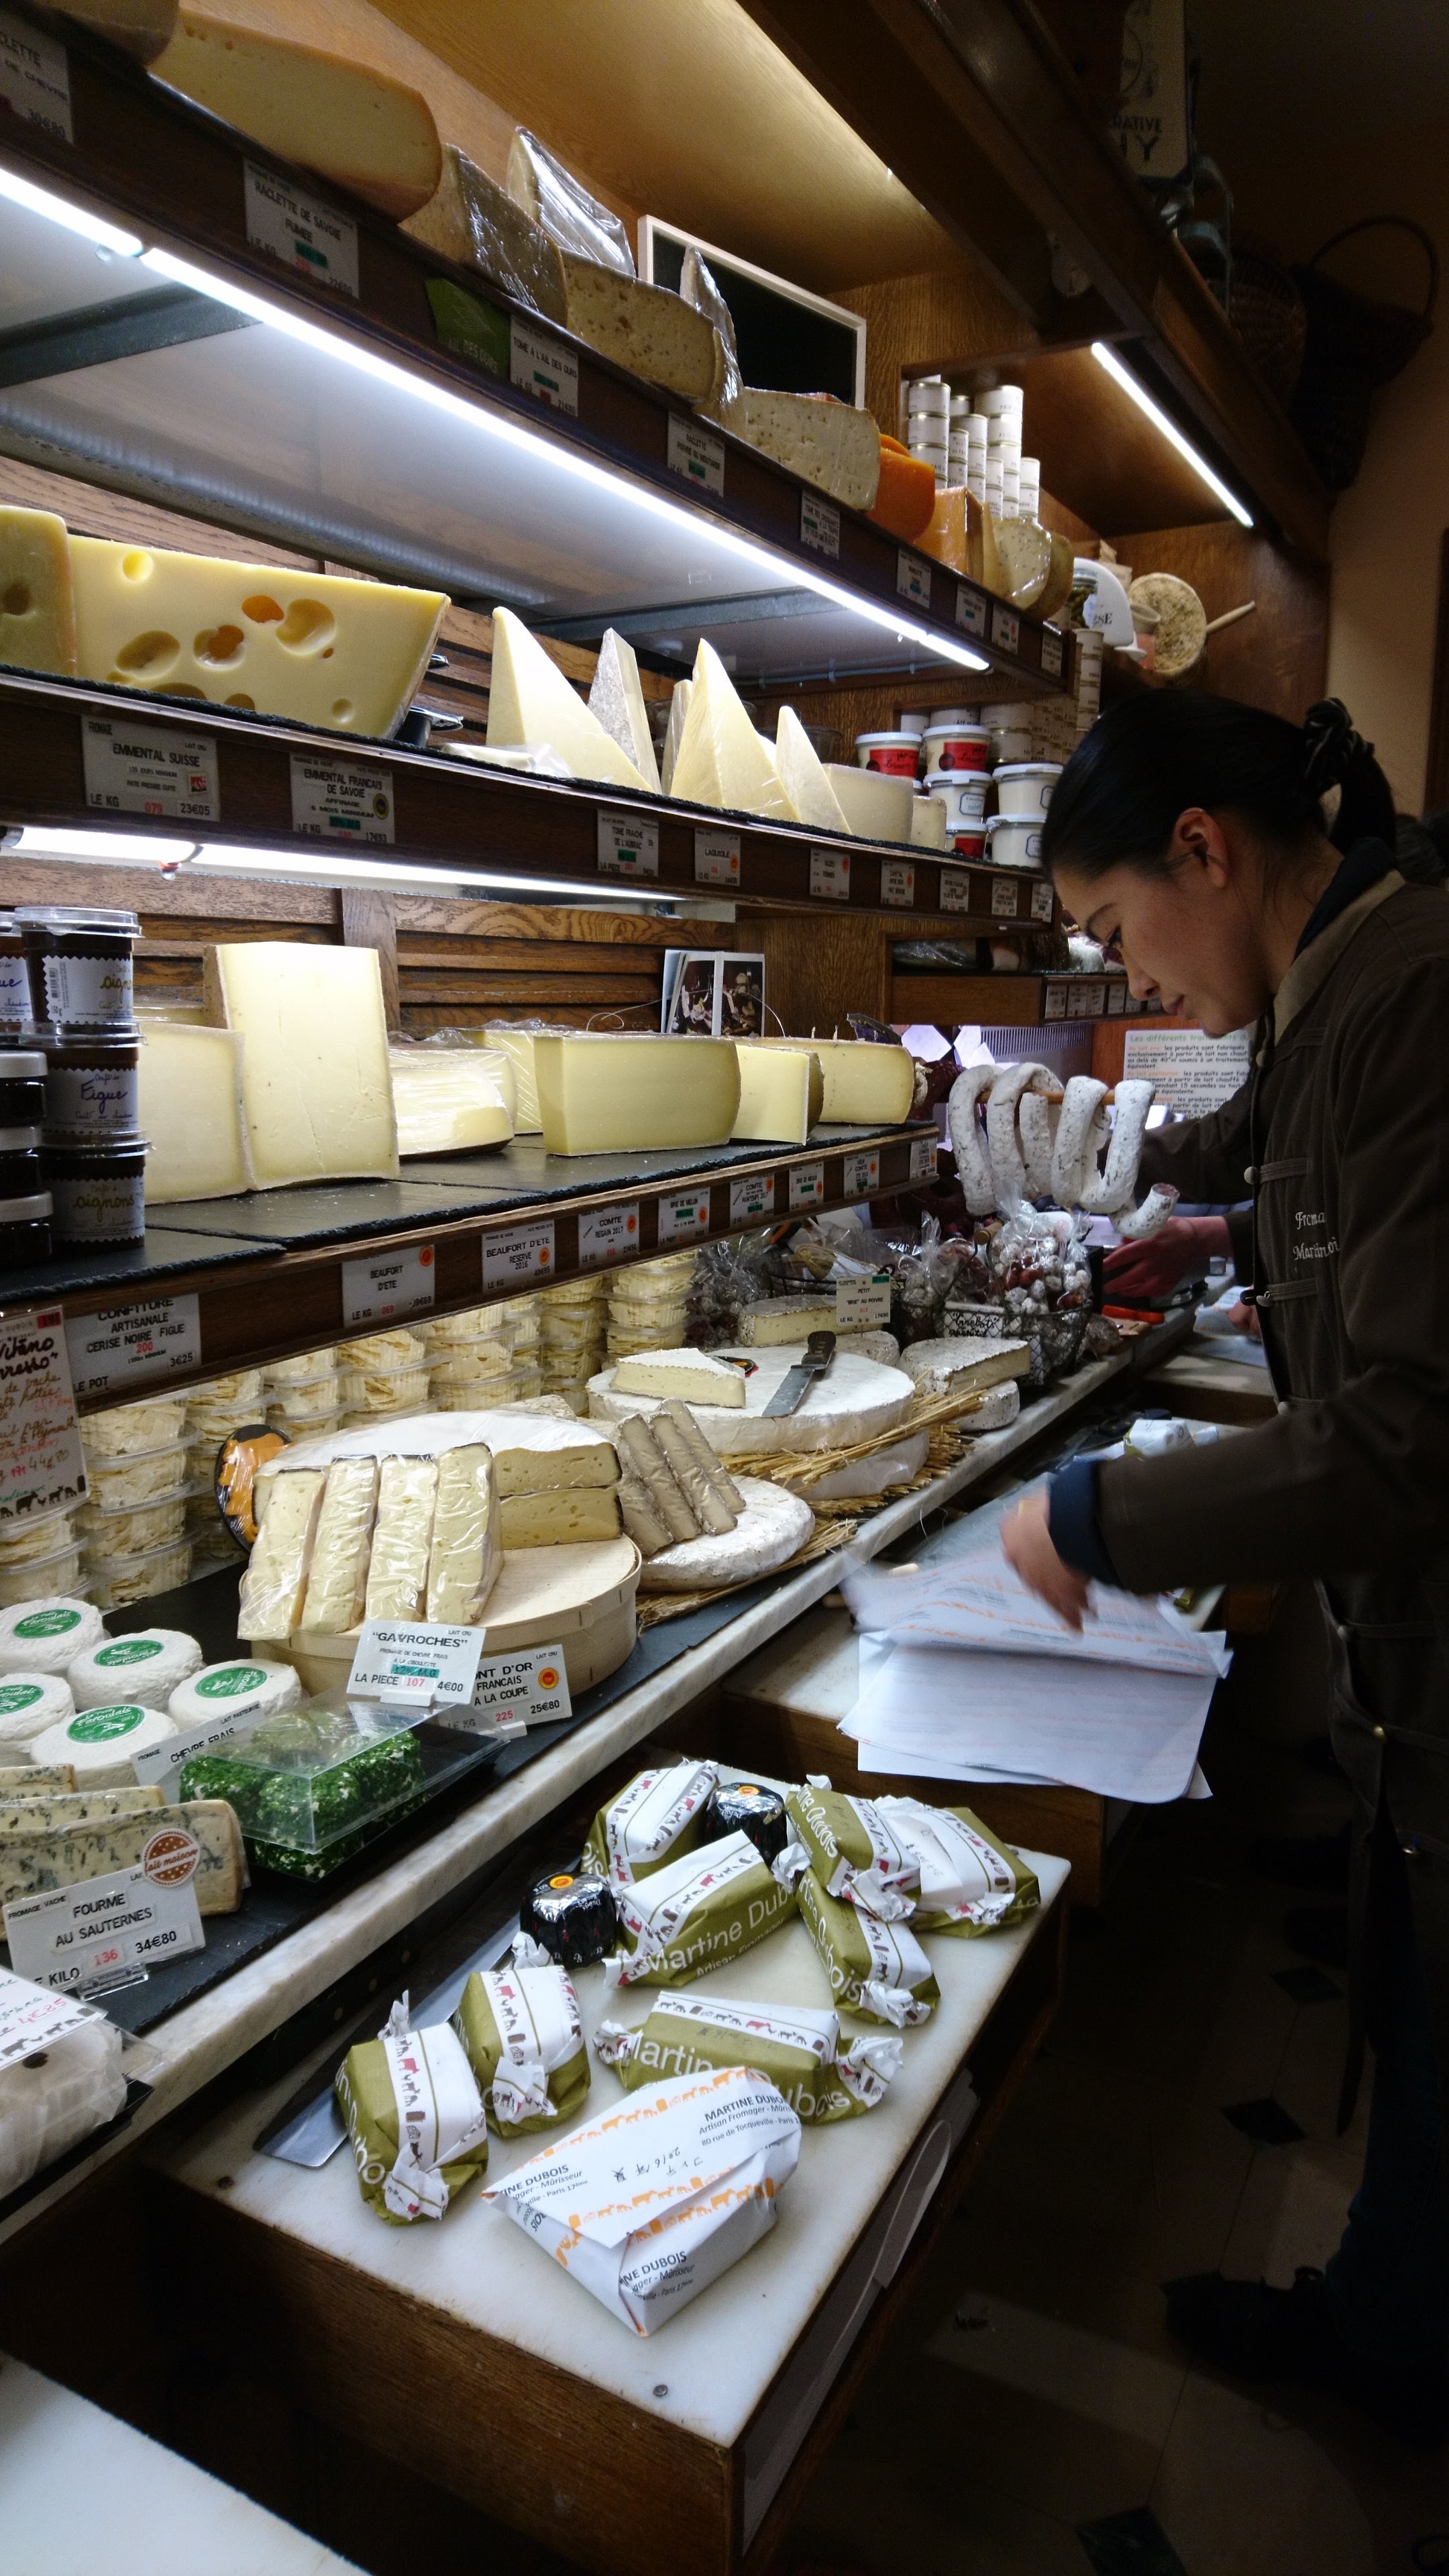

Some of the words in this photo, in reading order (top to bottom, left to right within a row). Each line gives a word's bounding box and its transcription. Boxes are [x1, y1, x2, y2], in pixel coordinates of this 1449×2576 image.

[256, 183, 298, 215] RACLETTE
[513, 337, 530, 356] TOME
[113, 743, 165, 762] EMMENTAL
[168, 753, 200, 767] SUISSE
[305, 769, 346, 784] EMMENTAL
[348, 775, 382, 790] FRANCAIS
[327, 784, 337, 794] DE
[340, 786, 365, 798] SAVOIE
[90, 793, 101, 805] LE
[106, 795, 119, 808] KG
[180, 803, 210, 816] 23€05
[341, 809, 374, 818] MINIMUM
[299, 823, 307, 833] LE
[310, 824, 321, 833] KG
[612, 827, 625, 836] TOME
[80, 1078, 128, 1114] Figue
[746, 1182, 762, 1191] COMTE
[75, 1193, 135, 1222] oignons
[599, 1216, 621, 1227] COMTE
[595, 1228, 611, 1238] REGAIN
[613, 1226, 624, 1235] 2017
[486, 1242, 527, 1258] BEAUFORT
[529, 1237, 550, 1248] D'ETE
[510, 1252, 532, 1264] RESERVE
[515, 1262, 528, 1271] 2016
[370, 1265, 403, 1279] BEAUFORT
[378, 1280, 396, 1291] D'ETE
[111, 1312, 169, 1334] ARTISANALE
[87, 1337, 121, 1354] CERISE
[124, 1331, 152, 1345] NOIRE
[159, 1324, 185, 1338] FIGUE
[136, 1342, 154, 1354] 200
[75, 1381, 86, 1393] LE
[89, 1375, 108, 1390] POT
[169, 1352, 194, 1368] 3€25
[380, 1648, 402, 1656] FROMAGE
[502, 1662, 533, 1676] D'OR
[355, 1673, 368, 1682] LA
[372, 1675, 399, 1686] PIECE
[406, 1677, 425, 1688] 107
[437, 1681, 464, 1693] 4€00
[476, 1675, 523, 1690] FRANCAIS
[484, 1695, 497, 1705] LA
[499, 1686, 529, 1700] COUPE
[495, 1710, 514, 1723] 225
[530, 1699, 560, 1715] 25€80
[138, 1748, 162, 1762] FROMAGE
[8, 1905, 41, 1919] FROMAGE
[44, 1895, 67, 1908] VACHE
[72, 1892, 126, 1917] FOURME
[55, 1933, 74, 1947] AU
[78, 1908, 153, 1939] SAUTERNES
[48, 1967, 80, 1986] KILO
[93, 1949, 119, 1966] 136
[134, 1931, 177, 1953] 34€80
[704, 2096, 755, 2122] MARTINE
[754, 2092, 786, 2108] DUBO
[699, 2119, 727, 2135] Artisan
[728, 2108, 765, 2128] Fromager
[735, 2118, 773, 2135] Tocqueville
[525, 2164, 570, 2187] DUBOIS
[539, 2169, 583, 2189] Mûrisseur
[546, 2187, 566, 2198] Paris
[640, 2251, 688, 2275] DUBOIS
